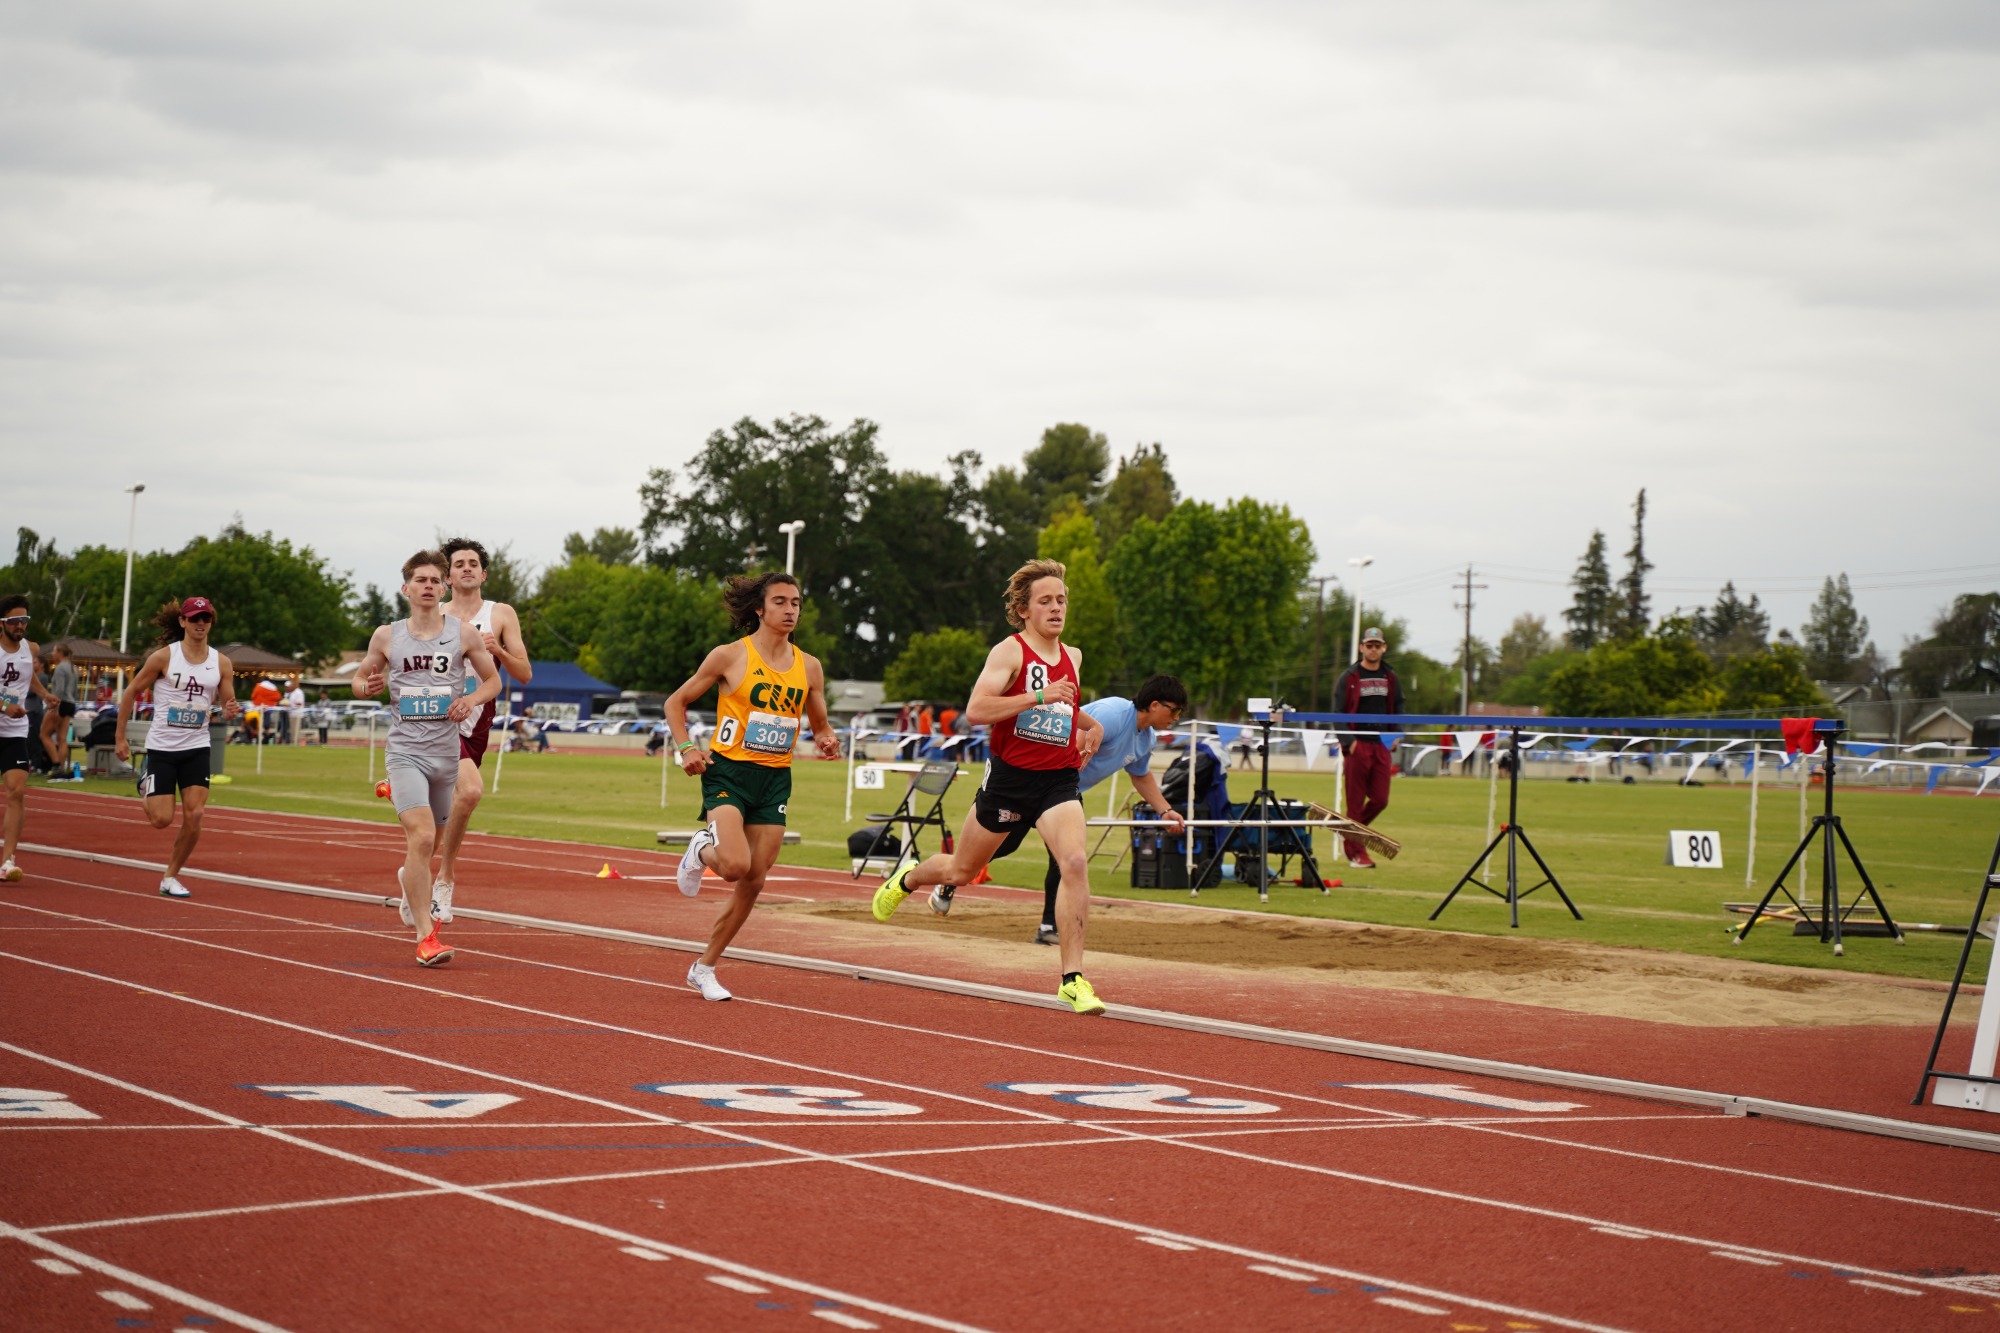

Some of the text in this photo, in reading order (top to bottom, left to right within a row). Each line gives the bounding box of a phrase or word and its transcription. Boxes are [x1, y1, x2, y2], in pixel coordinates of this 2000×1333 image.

[403, 655, 433, 673] ART
[434, 655, 449, 674] 3
[173, 673, 182, 689] 7
[1031, 665, 1044, 690] 8
[412, 700, 439, 713] 115
[177, 711, 198, 723] 159
[1028, 714, 1064, 734] 243
[720, 719, 734, 743] 6
[755, 728, 787, 746] 309
[1018, 729, 1067, 744] CHAMPIONSHIPS
[862, 770, 876, 784] 50
[1689, 835, 1712, 862] 80
